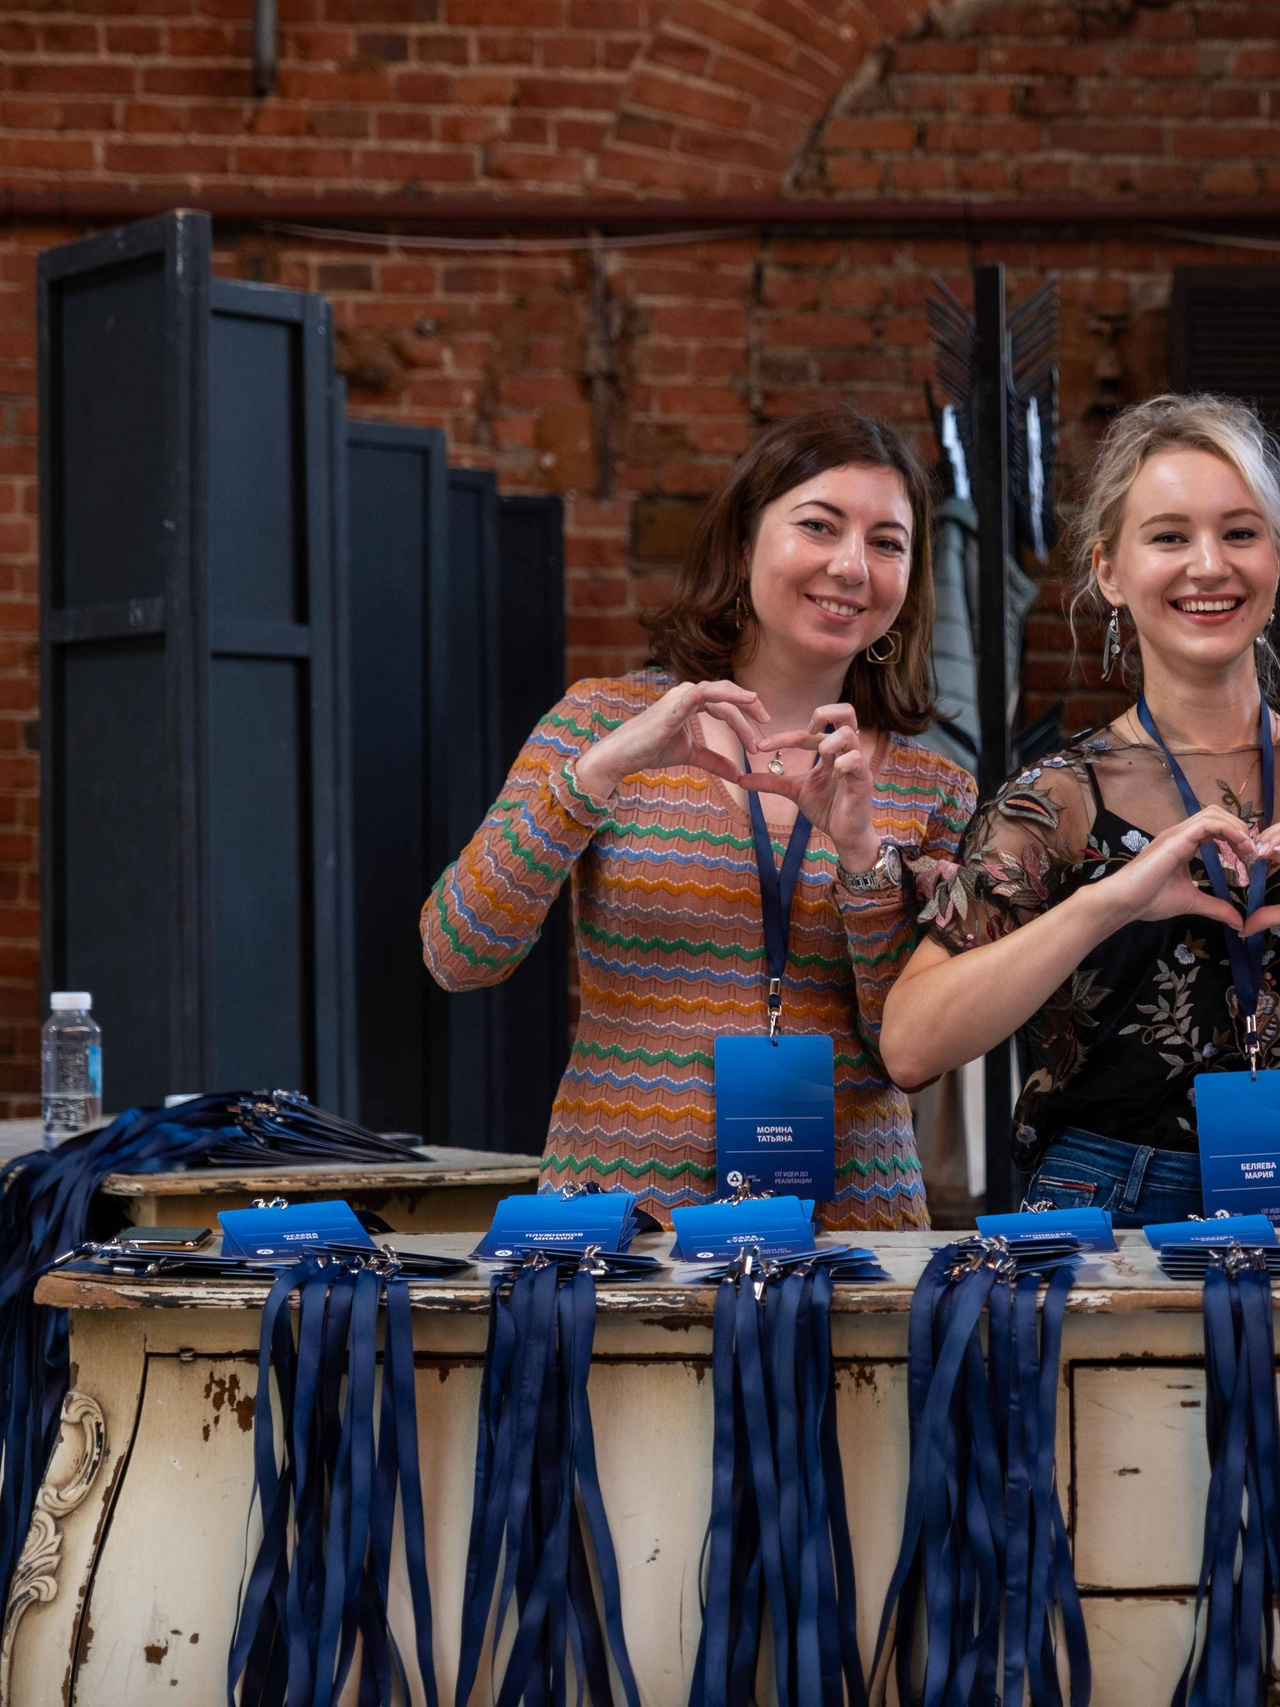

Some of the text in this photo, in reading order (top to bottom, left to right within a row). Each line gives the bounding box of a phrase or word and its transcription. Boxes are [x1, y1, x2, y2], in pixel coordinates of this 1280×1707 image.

[756, 1126, 793, 1134] МОРИНА
[756, 1135, 793, 1143] ТАТЬЯНА
[1241, 1162, 1277, 1170] БЕЛЯЕВА
[1245, 1171, 1274, 1179] МАРИЯ
